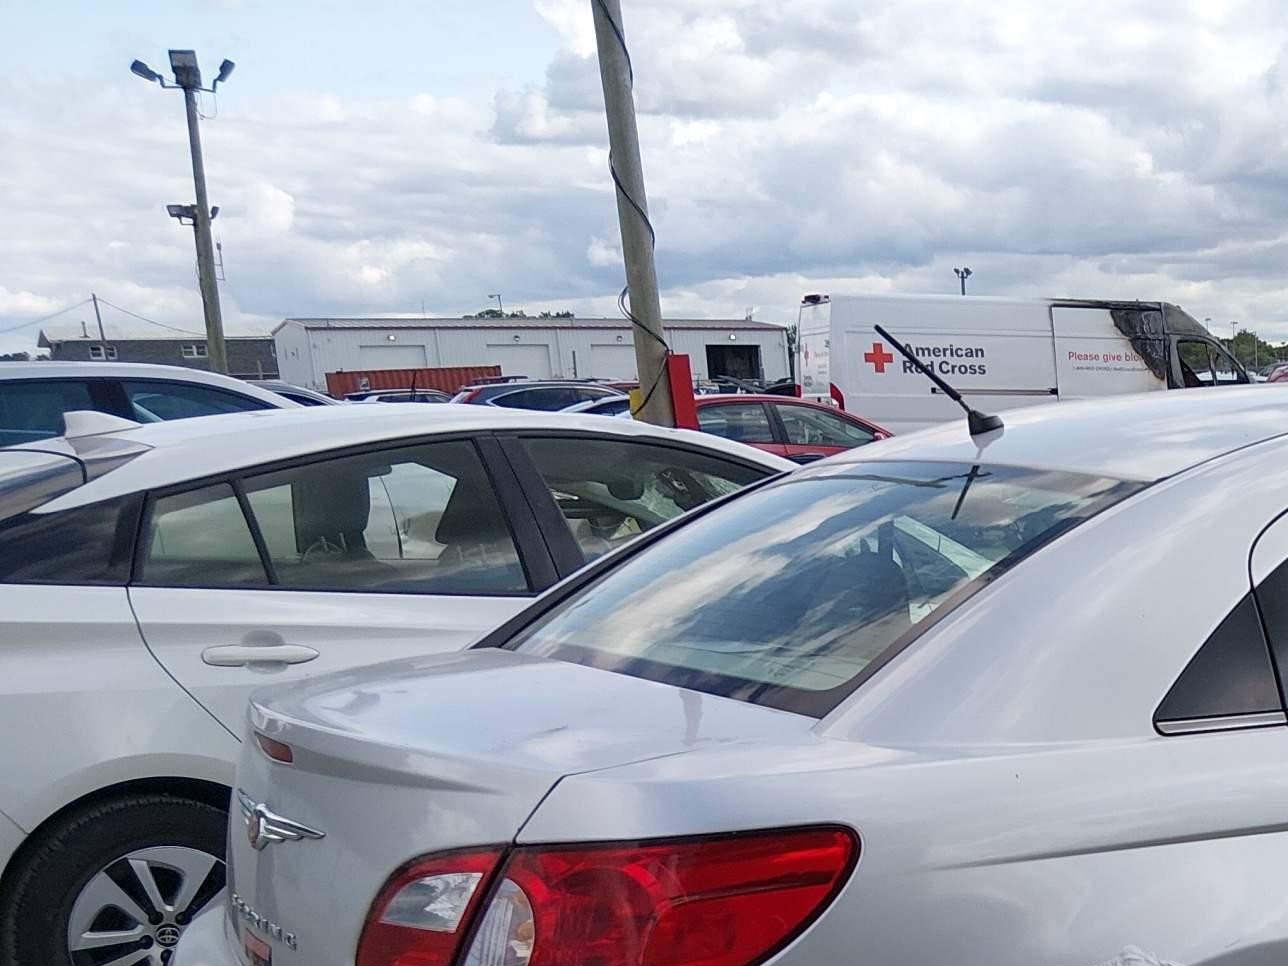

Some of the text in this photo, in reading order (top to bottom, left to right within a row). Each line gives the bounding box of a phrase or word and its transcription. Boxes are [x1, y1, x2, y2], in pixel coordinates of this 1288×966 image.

[1068, 351, 1100, 361] Please
[1102, 352, 1122, 363] give
[938, 360, 986, 375] Cross
